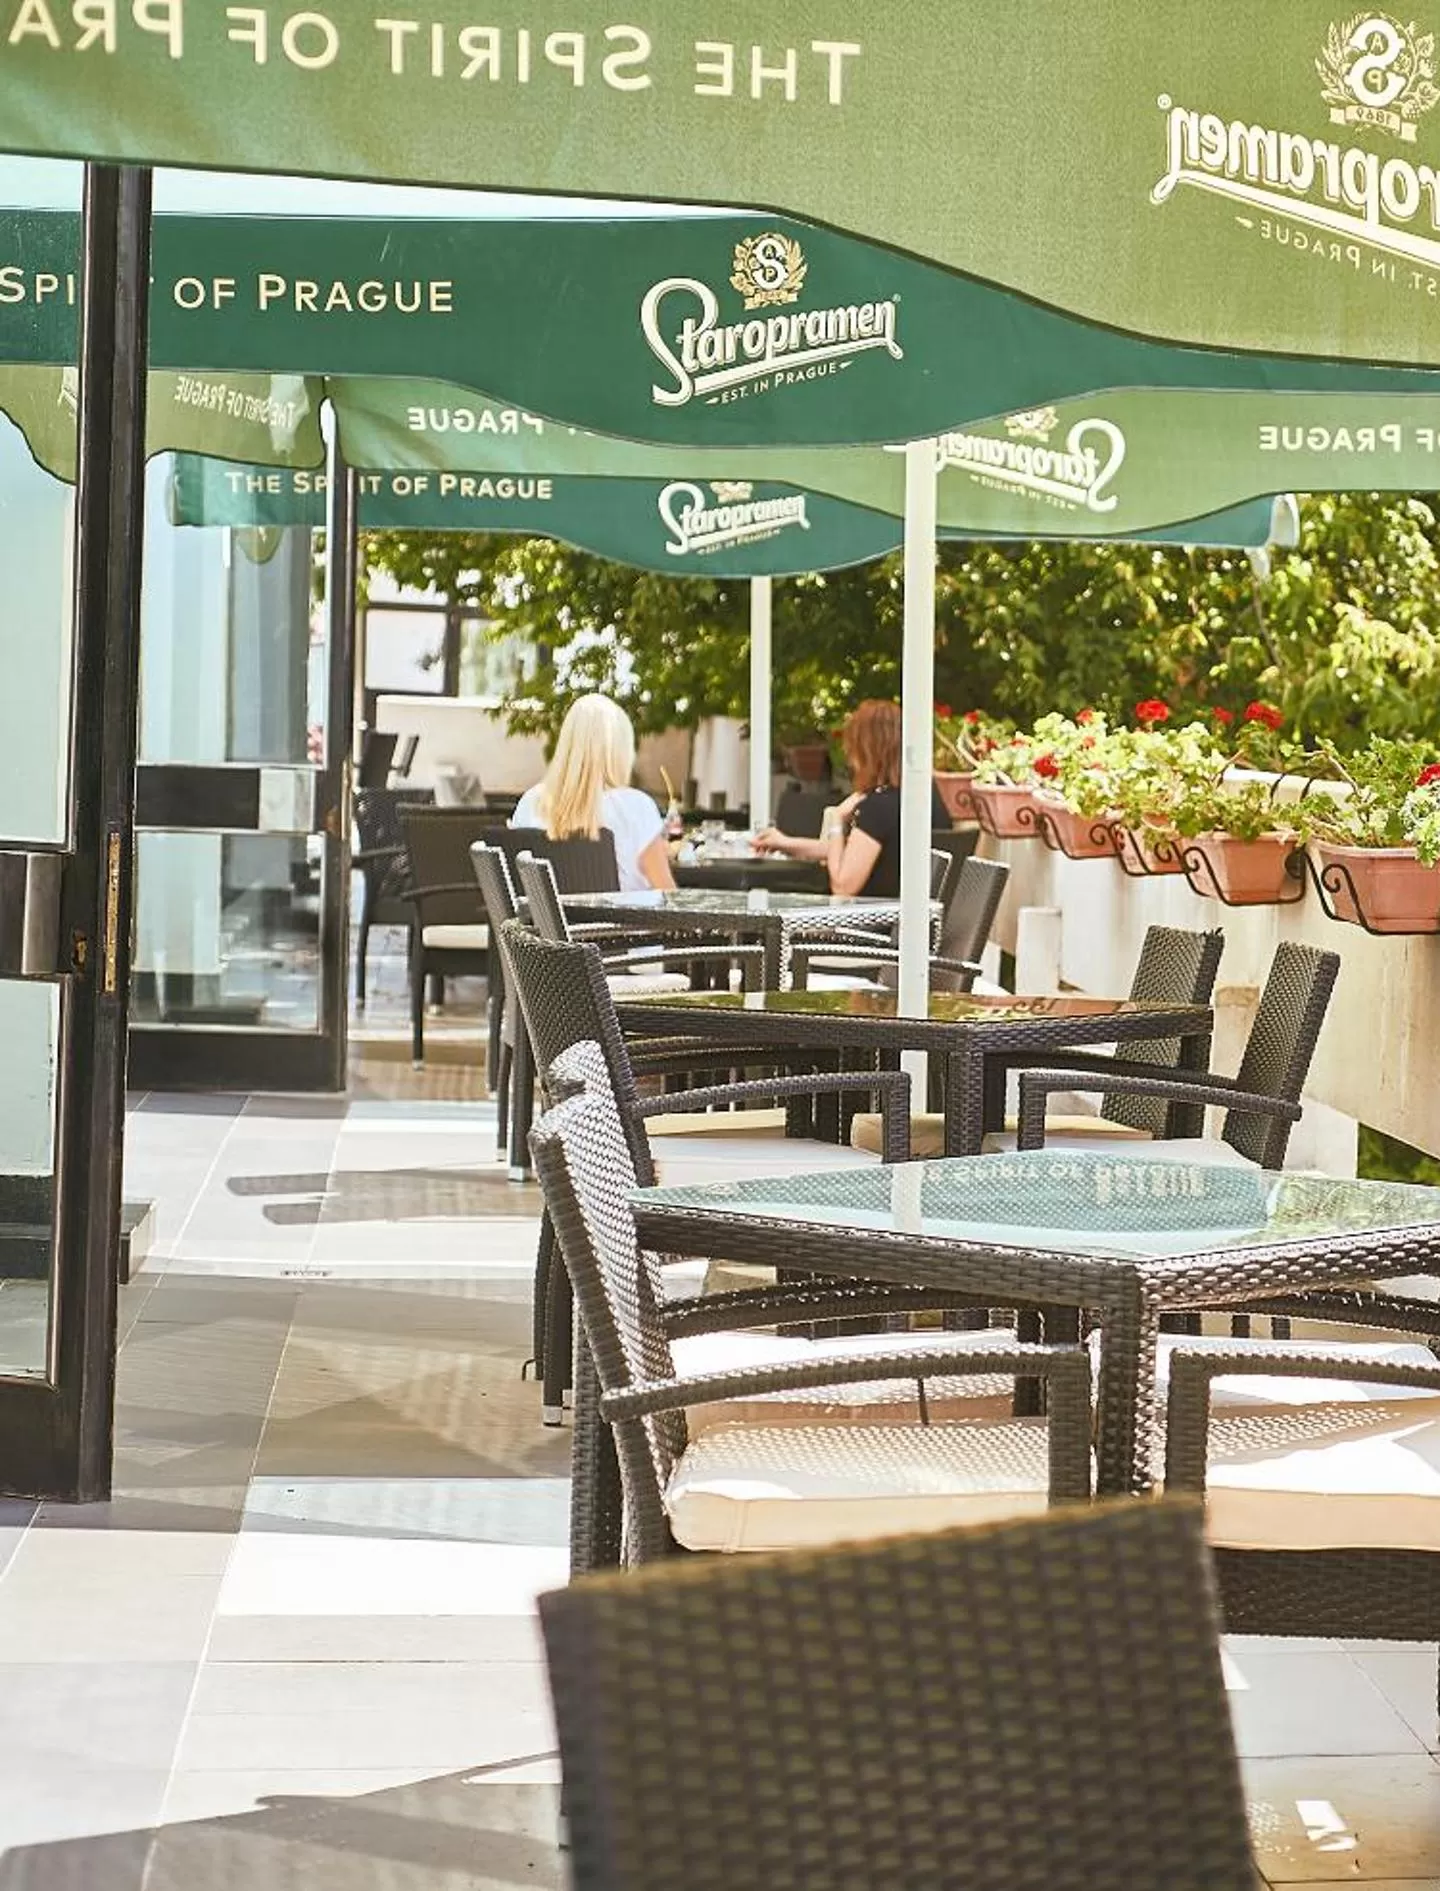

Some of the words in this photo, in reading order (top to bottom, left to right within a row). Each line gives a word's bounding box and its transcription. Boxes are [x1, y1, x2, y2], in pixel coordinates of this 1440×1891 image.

[174, 277, 236, 310] OF
[259, 274, 453, 313] PRAGUE
[641, 278, 903, 406] Staropramen
[753, 381, 769, 396] IN
[773, 361, 837, 389] PRAGUE
[224, 472, 282, 494] THE
[293, 471, 383, 496] SPIT
[391, 475, 430, 496] OF
[440, 472, 554, 500] PRAGUE
